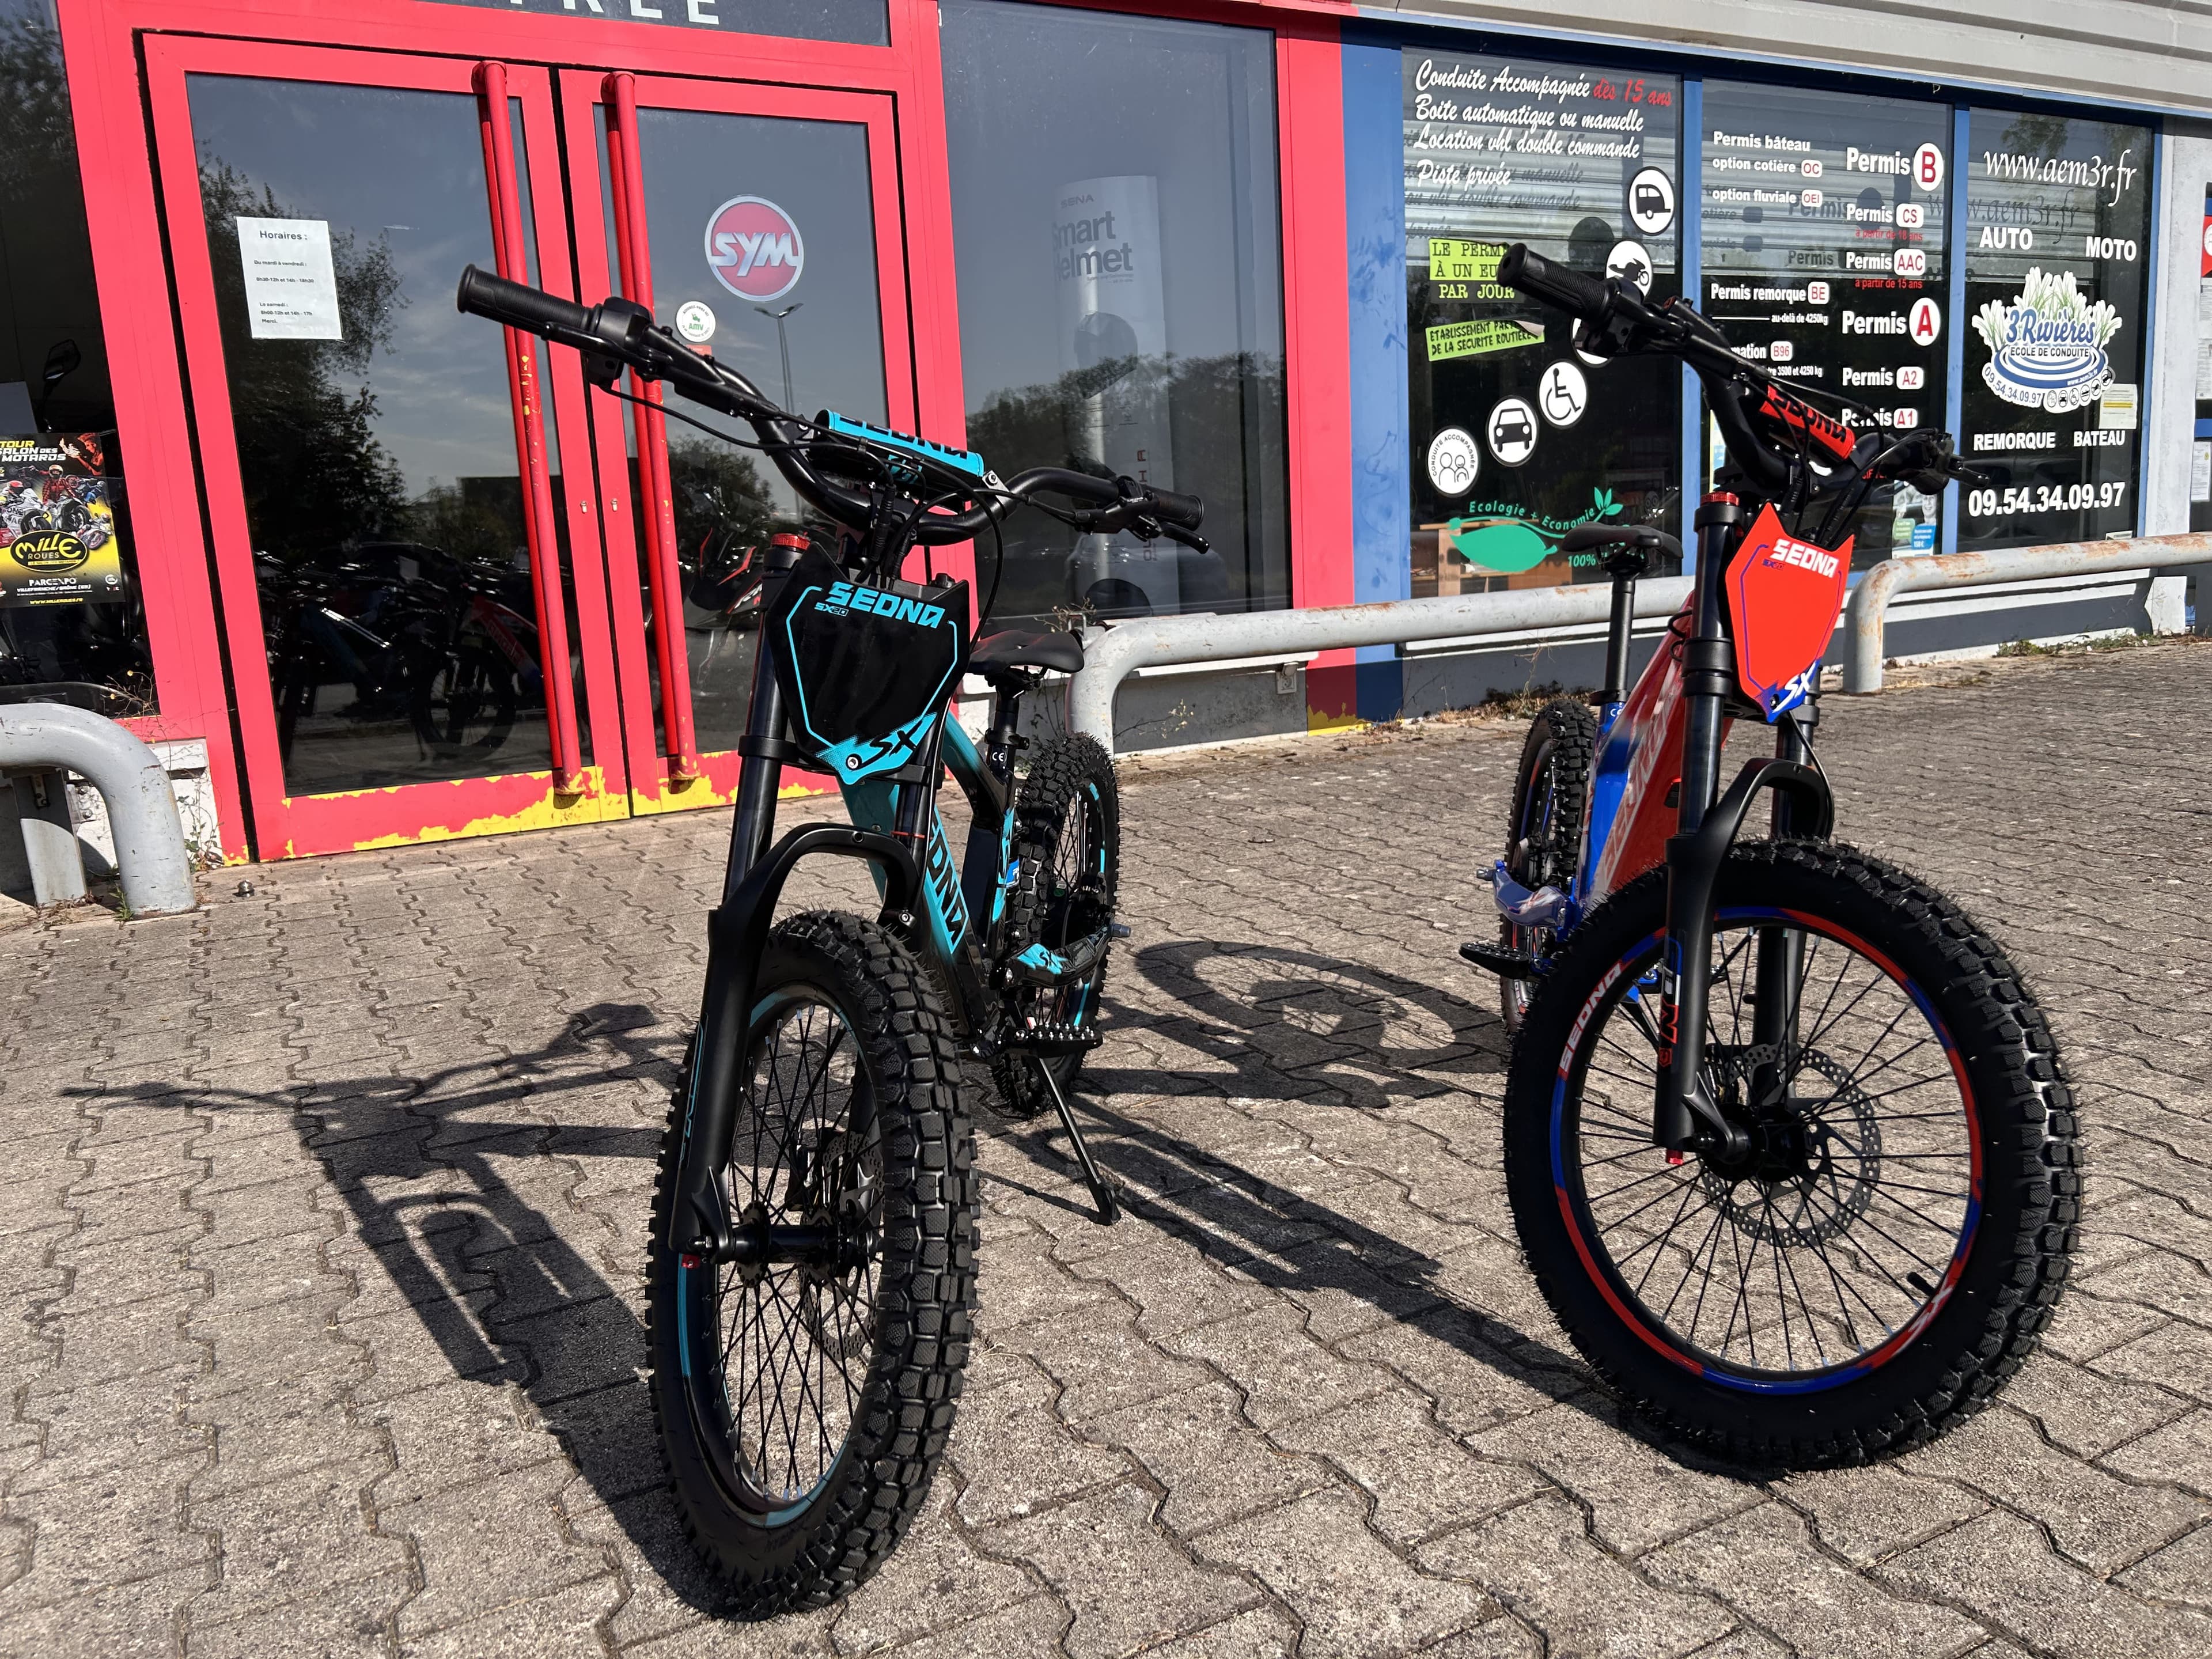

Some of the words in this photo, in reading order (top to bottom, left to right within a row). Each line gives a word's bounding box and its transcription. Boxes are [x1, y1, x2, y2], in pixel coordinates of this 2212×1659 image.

[1415, 59, 1487, 90] Conduite
[1490, 66, 1590, 103] Accompagnée
[1593, 78, 1616, 100] dès
[1624, 79, 1646, 102] 15
[1648, 92, 1672, 107] ans
[1415, 94, 1458, 120] Boite
[1463, 103, 1555, 134] automatique
[1560, 113, 1577, 127] ou
[1581, 109, 1643, 132] manuelle
[1414, 123, 1483, 150] Location
[1488, 126, 1511, 153] vhl
[1517, 130, 1562, 154] double
[1567, 137, 1640, 158] commande
[1713, 131, 1762, 149] Permis
[1765, 135, 1810, 152] bâteau
[1713, 157, 1751, 172] option
[1754, 160, 1796, 173] cotière
[1803, 163, 1820, 175] OC
[1846, 147, 1911, 175] Permis
[1922, 151, 1936, 183] B
[1416, 159, 1460, 187] Piste
[1464, 161, 1512, 194] privée
[1984, 149, 2138, 207] www.aem3r.fr
[1060, 194, 1094, 209] SENA
[1713, 188, 1751, 205] option
[1753, 189, 1797, 204] fluviale
[1846, 203, 1893, 224] Permis
[1903, 209, 1917, 224] CS
[260, 230, 302, 240] Horaires
[1862, 229, 1884, 240] partir
[1886, 229, 1896, 239] de
[1979, 226, 2033, 250] AUTO
[2086, 236, 2137, 261] MOTO
[713, 232, 798, 276] SYM
[1433, 243, 1450, 256] LE
[1435, 260, 1445, 277] À
[1452, 264, 1472, 277] UN
[1846, 252, 1892, 270] Permis
[1897, 255, 1923, 271] AAC
[1438, 284, 1468, 298] PAR
[1477, 284, 1515, 298] JOUR
[1711, 283, 1751, 300] Permis
[1753, 286, 1806, 304] remorque
[1811, 286, 1825, 300] BE
[1862, 278, 1884, 290] partir
[1885, 279, 1895, 288] de
[1897, 278, 1907, 289] 15
[1908, 281, 1923, 289] ans
[1771, 313, 1795, 323] au-delà
[1796, 314, 1804, 323] de
[1805, 314, 1828, 325] 4250kg
[1842, 310, 1907, 335] Permis
[1916, 305, 1933, 336] A
[2006, 309, 2019, 343] 3
[2020, 308, 2096, 344] Rivières
[1430, 321, 1491, 342] ETABLISSEMENT
[1431, 344, 1441, 355] DE
[1445, 341, 1453, 353] LA
[1457, 335, 1493, 351] SECURITE
[1774, 346, 1789, 357] B96
[2010, 347, 2036, 356] ECOLE
[2038, 347, 2048, 357] DE
[2050, 347, 2089, 357] CONDUITE
[1777, 366, 1791, 376] 3500
[1792, 366, 1799, 376] et
[1800, 366, 1814, 376] 4250
[1815, 365, 1823, 377] kg
[1843, 368, 1893, 386] Permis
[1902, 371, 1917, 385] A2
[1984, 366, 2041, 404] 09.54.34.09.97
[1896, 411, 1914, 426] A1
[1974, 432, 2056, 450] REMORQUE
[2074, 430, 2125, 447] BATEAU
[0, 447, 40, 455] ALON
[2, 453, 66, 461] MOTARDS
[1431, 440, 1443, 476] CONDUITE
[1968, 482, 2125, 517] 09.54.34.09.97
[1469, 500, 1525, 516] Ecologie
[1541, 507, 1595, 531] Economie
[1568, 554, 1596, 567] 100%
[1770, 539, 1839, 578] SEDNA
[825, 581, 945, 628] SEDNA
[855, 719, 925, 770] SX
[992, 751, 1005, 762] CE
[1559, 963, 1622, 1070] SEDNA
